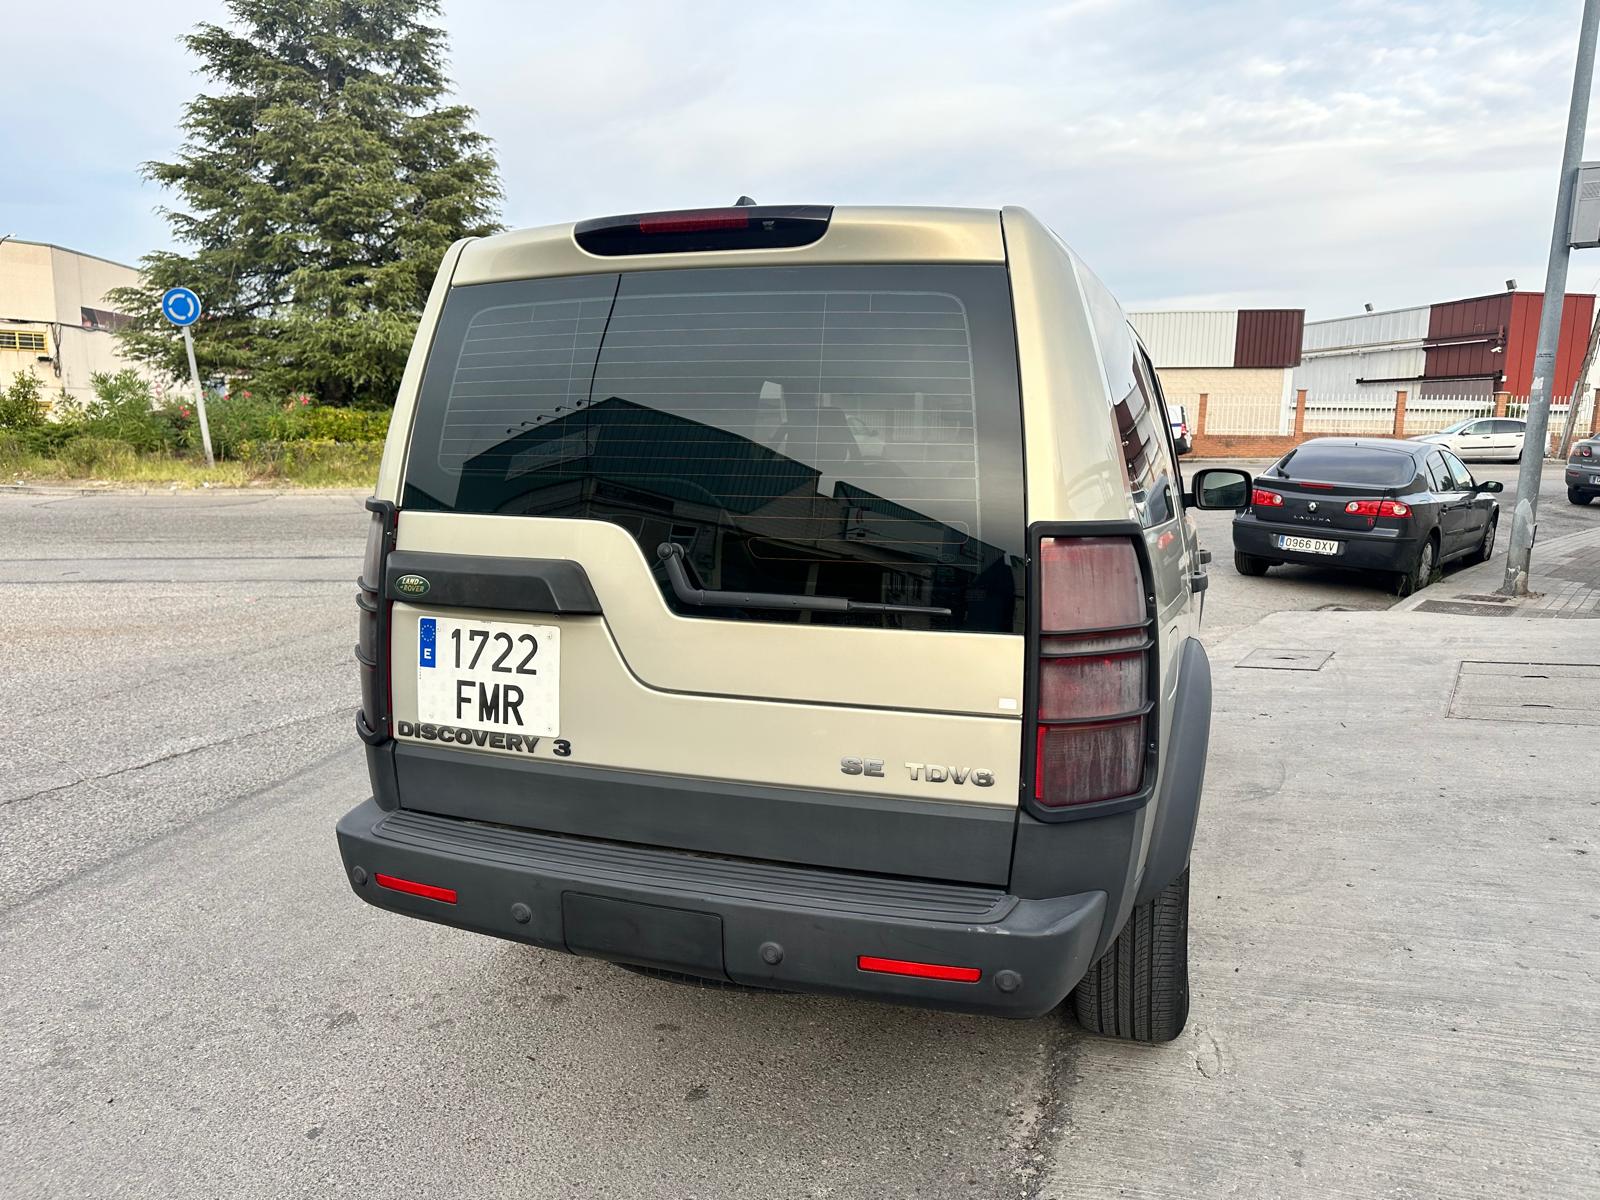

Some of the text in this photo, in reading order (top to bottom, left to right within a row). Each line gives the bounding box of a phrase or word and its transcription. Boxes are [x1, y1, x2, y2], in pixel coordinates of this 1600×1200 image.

[1285, 537, 1335, 552] 0966 DXV
[401, 577, 420, 585] LAND
[403, 584, 425, 593] ROVER
[423, 648, 432, 660] E
[451, 628, 539, 676] 1722
[456, 679, 524, 726] FMR
[397, 720, 572, 757] DISCOVERY 3
[840, 755, 995, 788] SE TDV6
